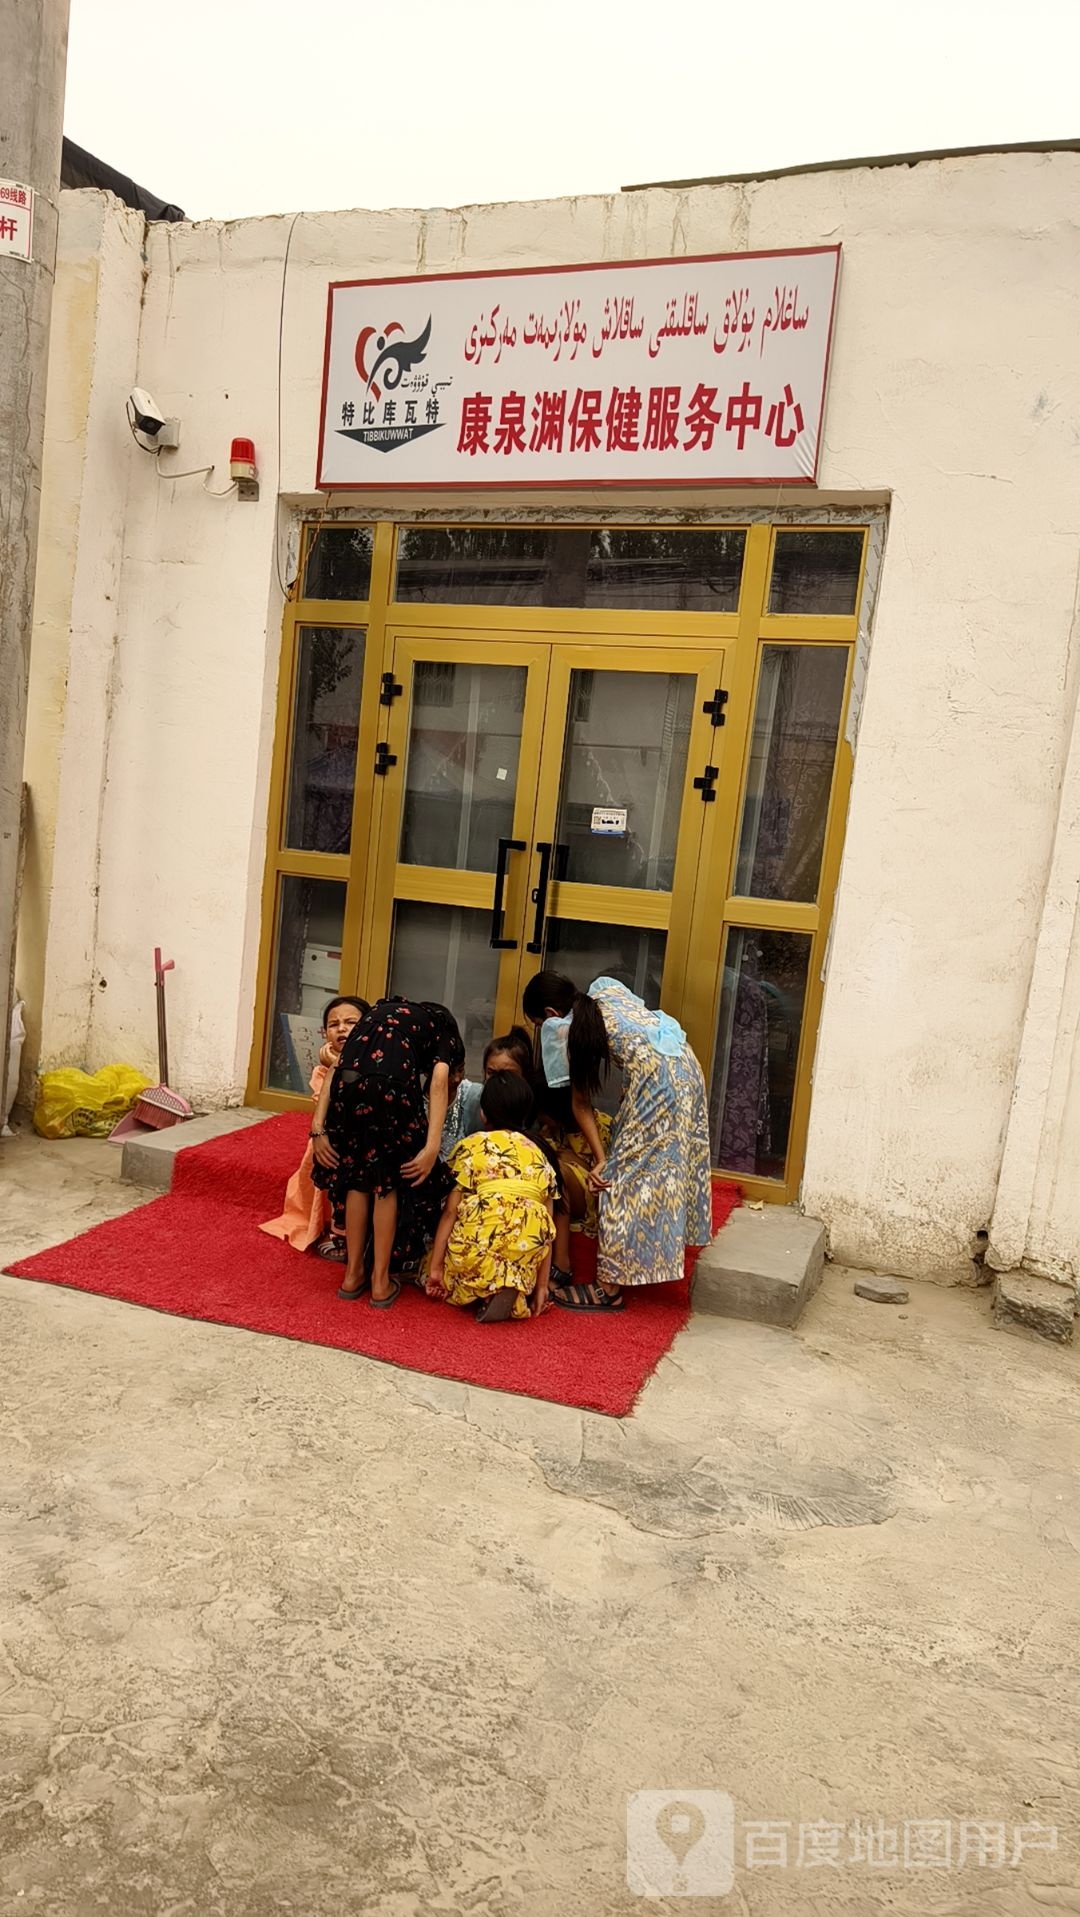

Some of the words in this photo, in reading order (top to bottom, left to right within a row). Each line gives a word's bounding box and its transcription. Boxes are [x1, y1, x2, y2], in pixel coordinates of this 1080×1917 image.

[464, 303, 517, 365] مەركىزى
[523, 299, 587, 361] مۇلازىمەت
[592, 296, 644, 358] ساقلاش
[649, 291, 709, 358] ساقلىقنى
[713, 288, 755, 353] بۇلاق
[760, 284, 809, 359] ساغلام
[341, 399, 440, 427] 特比库瓦特
[363, 427, 414, 442] TIBBIKUWWAT
[456, 382, 804, 456] 康泉渊保健服务中心
